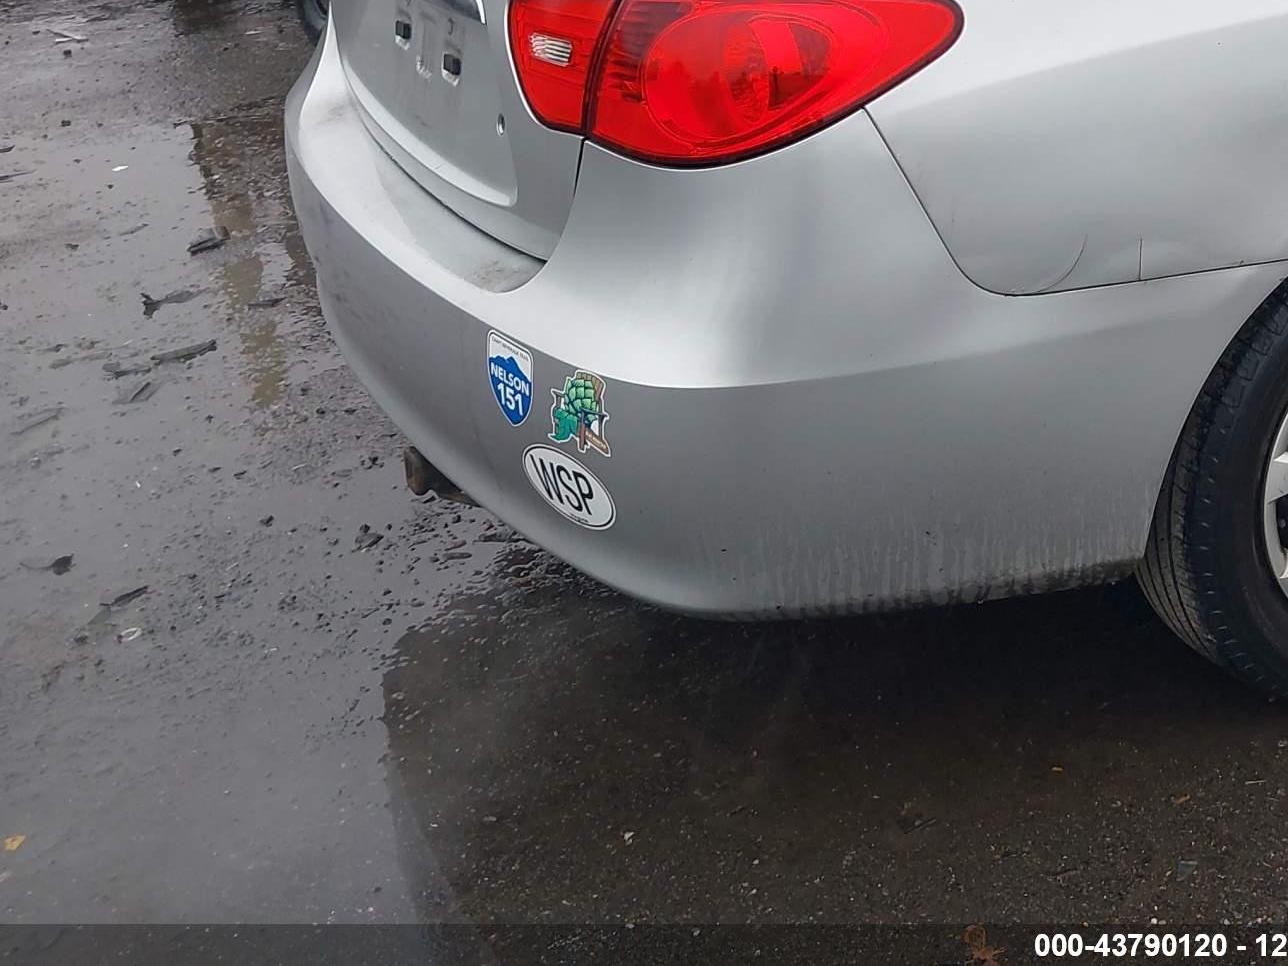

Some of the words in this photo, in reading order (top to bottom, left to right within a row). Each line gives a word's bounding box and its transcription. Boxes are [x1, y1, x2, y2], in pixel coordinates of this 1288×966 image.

[490, 362, 530, 397] NELSON
[497, 382, 524, 416] 151
[529, 453, 594, 516] WSP
